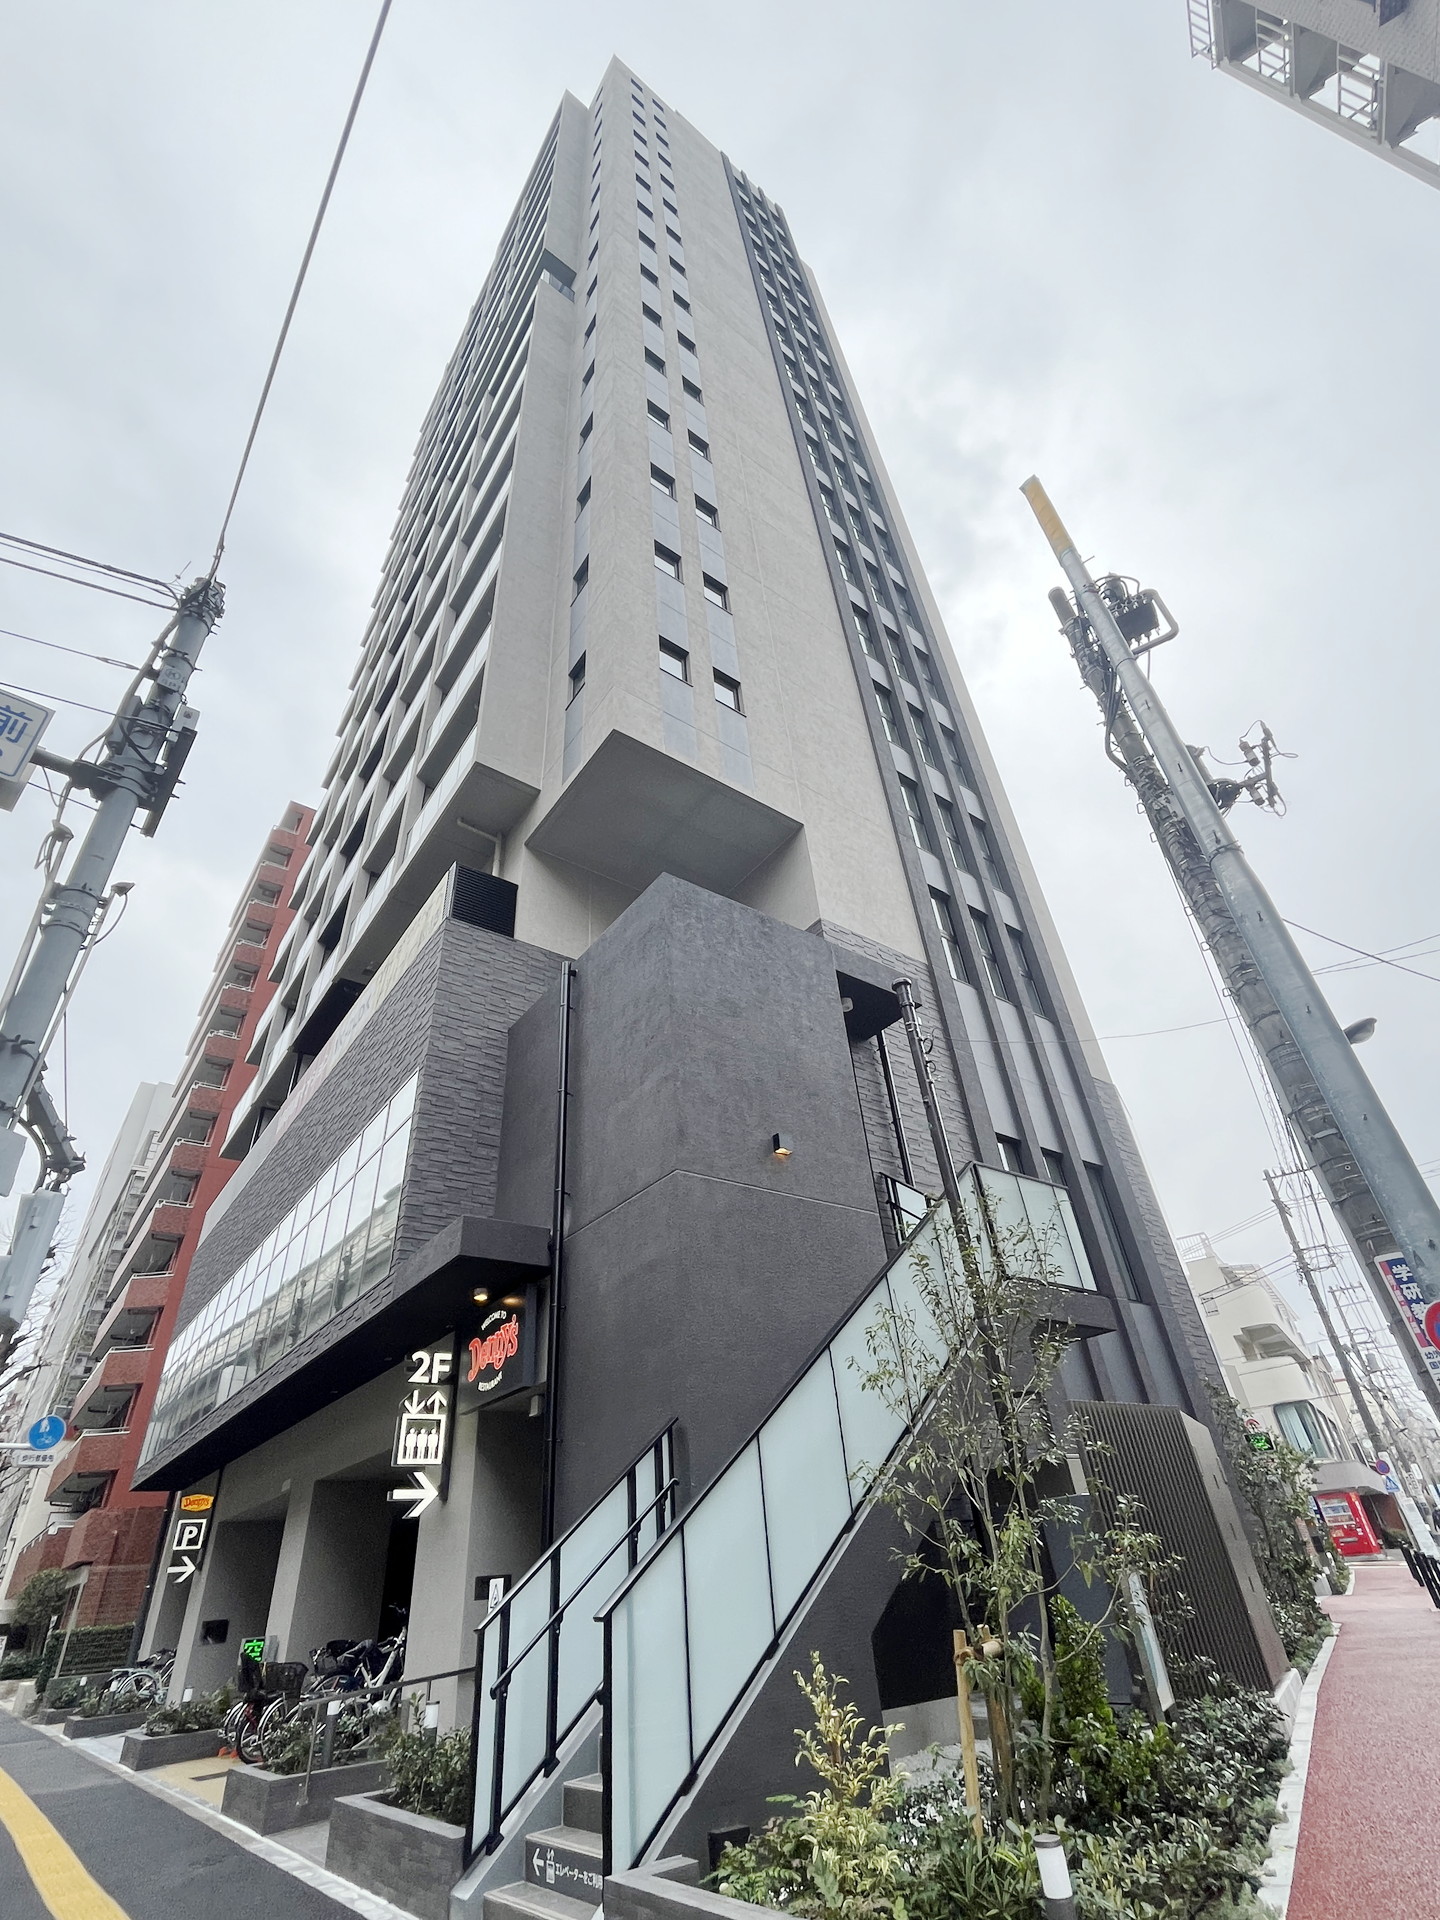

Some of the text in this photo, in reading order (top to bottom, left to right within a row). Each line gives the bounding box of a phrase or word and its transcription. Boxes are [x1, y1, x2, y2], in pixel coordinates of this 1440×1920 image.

[1391, 1263, 1429, 1333] 学研教
[408, 1351, 452, 1384] 2F
[468, 1314, 518, 1382] Denny's
[181, 1525, 198, 1547] P
